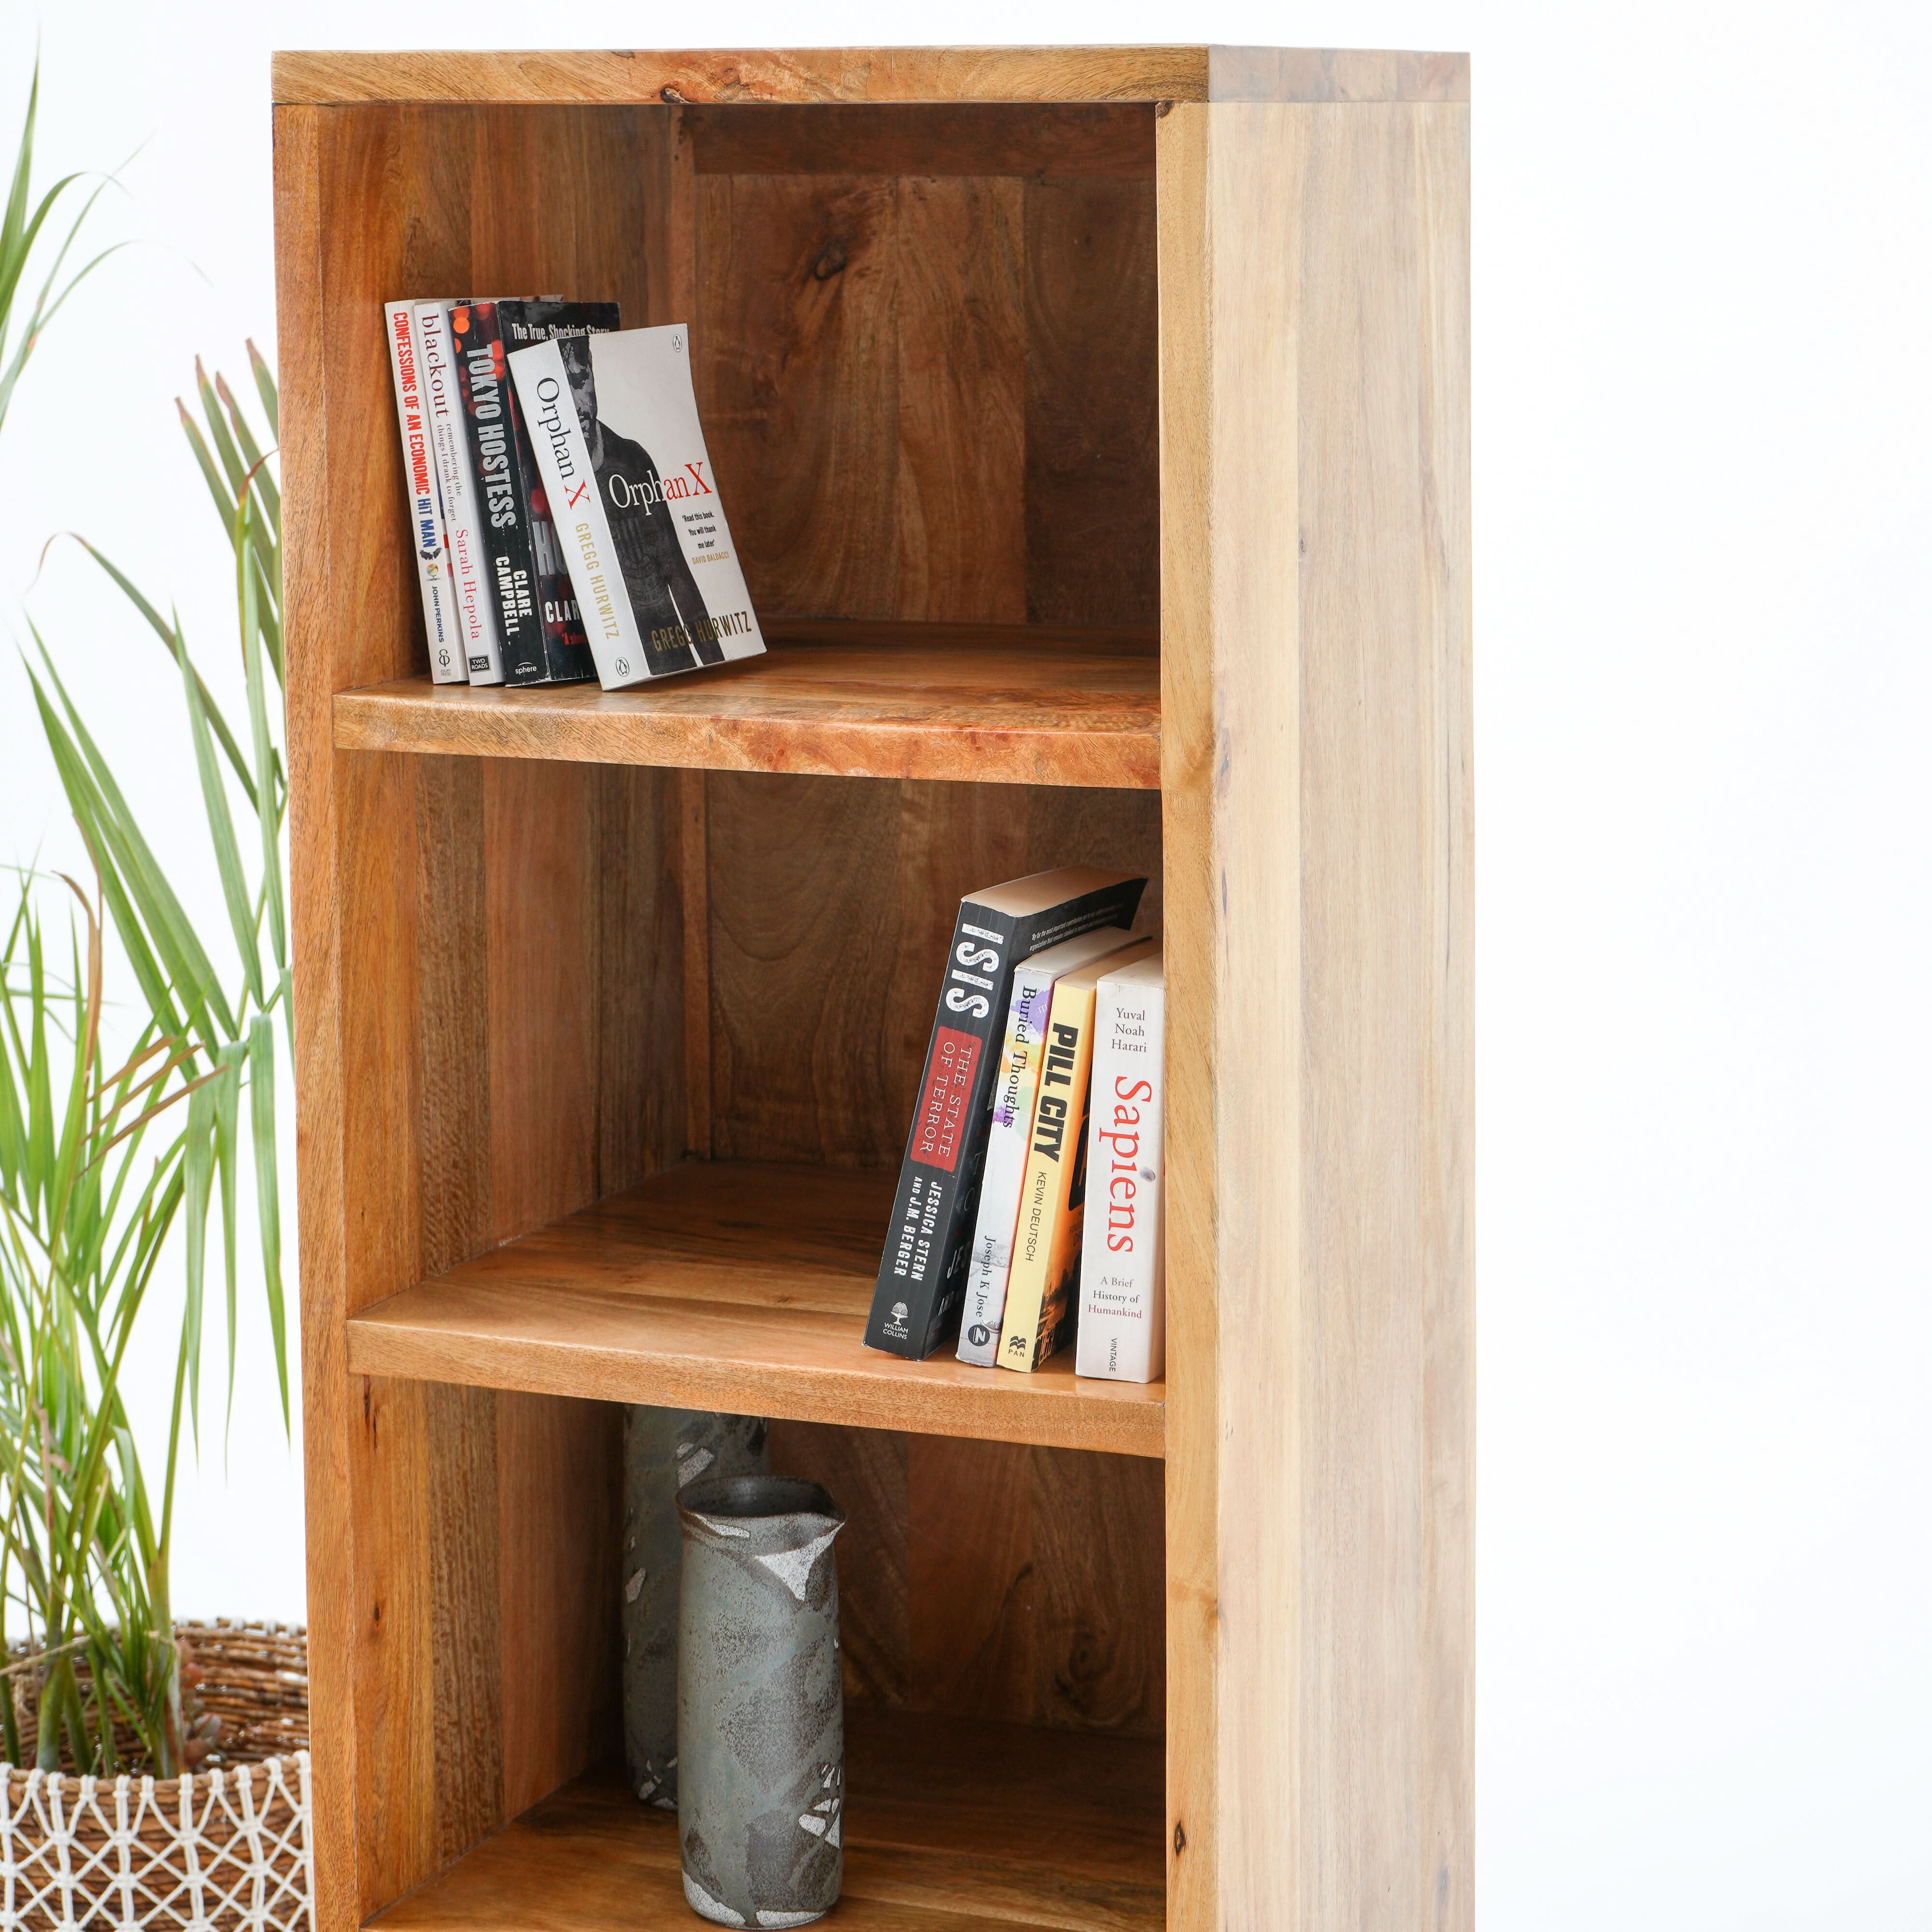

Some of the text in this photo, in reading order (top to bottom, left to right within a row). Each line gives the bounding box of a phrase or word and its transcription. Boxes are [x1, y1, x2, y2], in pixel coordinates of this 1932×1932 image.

[511, 323, 528, 340] The
[394, 312, 417, 392] CONFESSIONS
[421, 313, 449, 418] blackout
[404, 395, 419, 410] OF
[406, 414, 422, 431] AN
[437, 425, 445, 452] things
[467, 343, 516, 528] TOKYO HOSTESS
[446, 423, 459, 481] remembering
[537, 377, 590, 510] Orphan X
[410, 434, 430, 495] ECONOMIC
[443, 459, 452, 483] drank
[446, 484, 452, 495] to
[609, 462, 712, 516] Orphan X
[448, 497, 456, 522] forget
[420, 519, 437, 548] MAN
[704, 525, 717, 533] thank
[692, 551, 729, 564] DAVID BALDACCI
[456, 529, 482, 639] Sarah Hepola
[496, 556, 520, 636] CAMPBELL
[513, 570, 532, 617] CLARE
[576, 523, 620, 639] GREGG HURWITZ
[435, 608, 444, 642] PERKINS
[545, 599, 580, 623] CLAR
[651, 611, 752, 653] GREGG HURWITZ
[515, 665, 537, 675] sphere
[945, 923, 1004, 1019] ISIS
[1115, 1023, 1145, 1036] Noah
[1116, 1008, 1145, 1021] Yuval
[1003, 985, 1037, 1128] Buried Thoughts
[1111, 1038, 1147, 1052] Harari
[919, 1041, 955, 1152] OF TERROR
[938, 1047, 972, 1157] THE STATE
[1034, 1022, 1078, 1163] PILL CITY
[1098, 1075, 1152, 1254] Sapiens
[894, 1176, 923, 1277] AND J.M. BERGER
[910, 1181, 943, 1281] JESSICA STERN
[1025, 1171, 1047, 1261] KEVIN DEUTSCH
[976, 1235, 996, 1317] Joseph K Jose
[1100, 1277, 1134, 1287] A Brief
[1088, 1304, 1142, 1319] Humankind
[1093, 1290, 1140, 1304] History of
[882, 1328, 908, 1340] COLLINS
[884, 1322, 909, 1333] WILLIAM
[1009, 1349, 1024, 1357] PAN
[1109, 1338, 1117, 1372] VINTAGE
